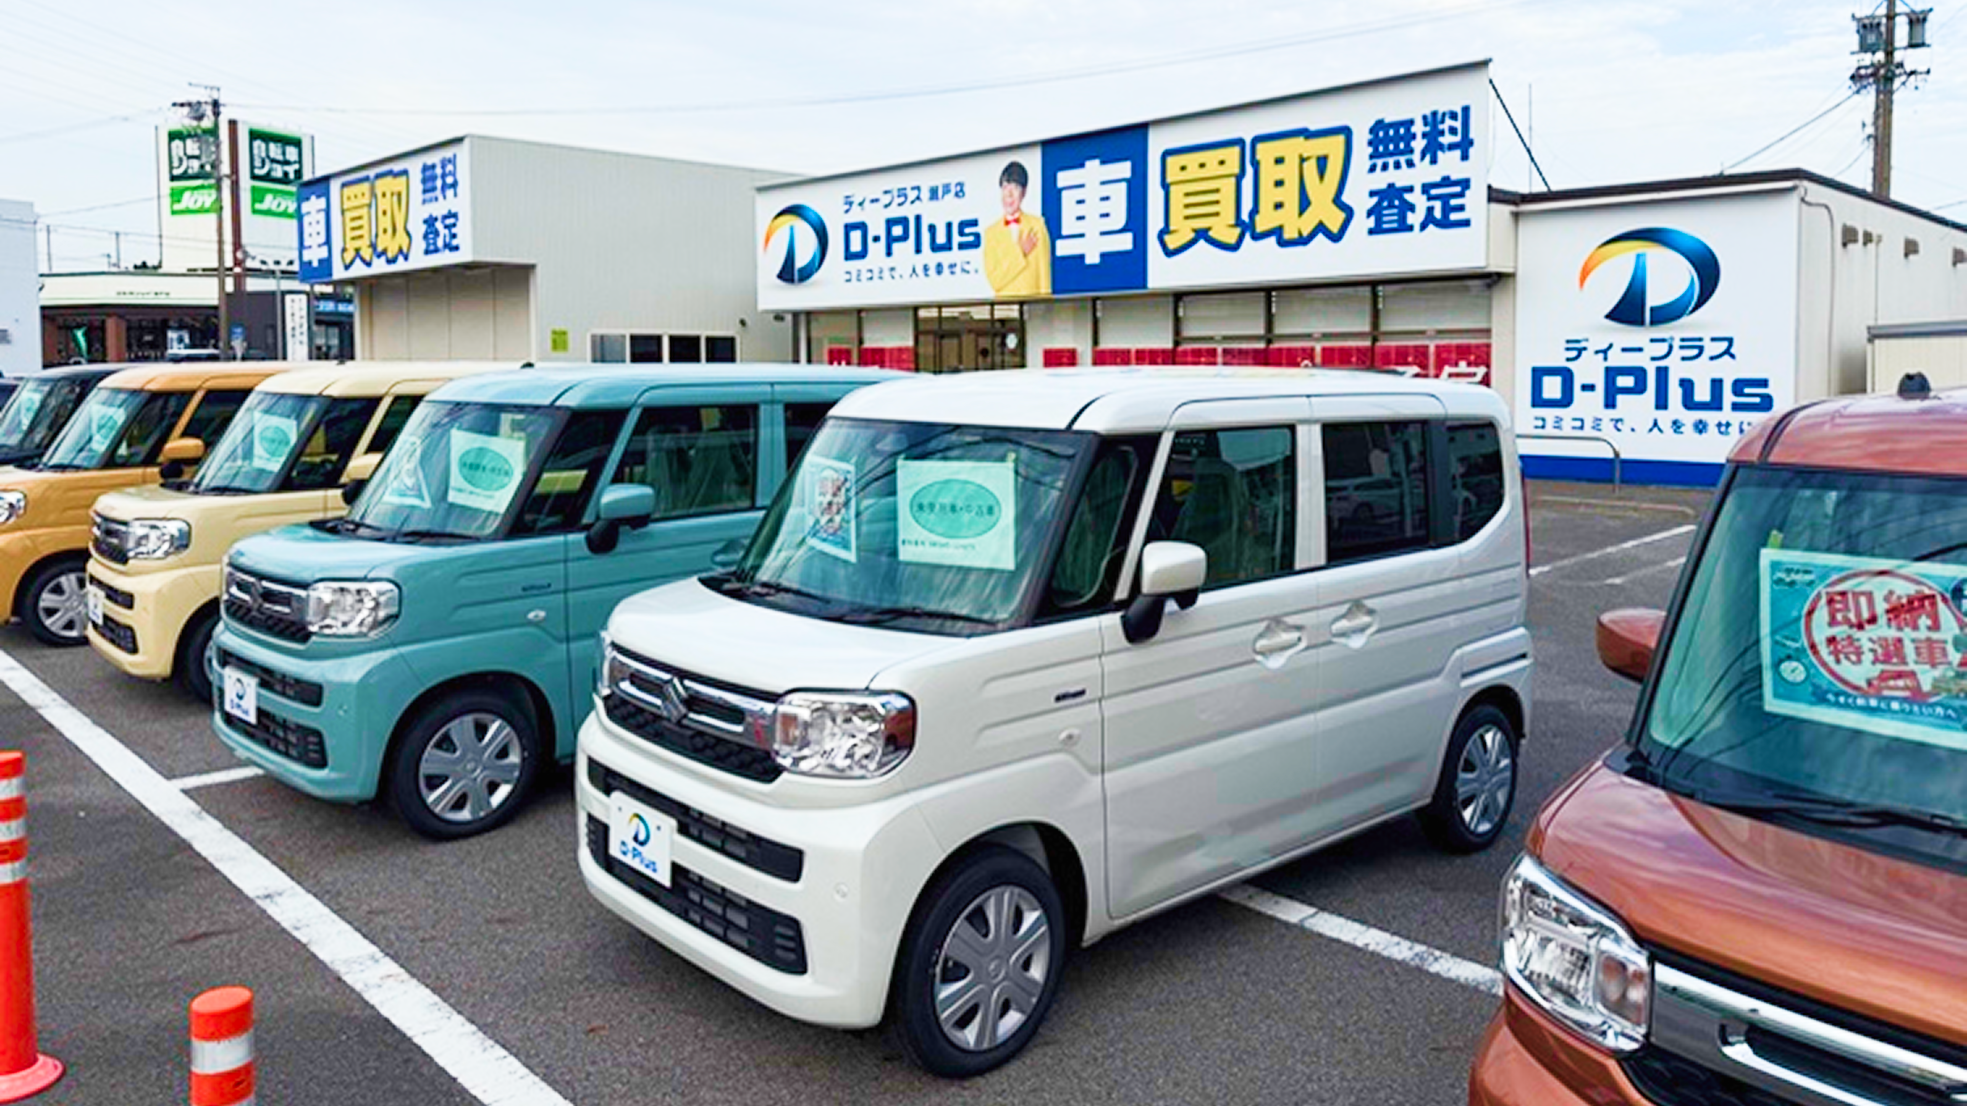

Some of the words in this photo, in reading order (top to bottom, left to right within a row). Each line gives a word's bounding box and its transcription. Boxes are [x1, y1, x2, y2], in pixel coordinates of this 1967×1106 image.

[1366, 104, 1475, 174] 無料
[173, 189, 217, 211] JOY
[421, 153, 458, 205] 無料
[843, 184, 923, 214] ディープラス
[1055, 158, 1134, 265] 車
[1157, 125, 1354, 258] 買取
[254, 193, 298, 214] JOY
[301, 194, 329, 268] 車
[341, 168, 413, 272] 買取
[1366, 175, 1472, 236] 査定
[422, 209, 460, 256] 査定
[843, 213, 982, 262] D-Plus
[1563, 336, 1737, 363] ディープラス
[1530, 365, 1775, 414] D-Plus
[1825, 589, 1941, 633] 即納
[1825, 634, 1950, 668] 特選車
[619, 839, 658, 874] D-Plus
